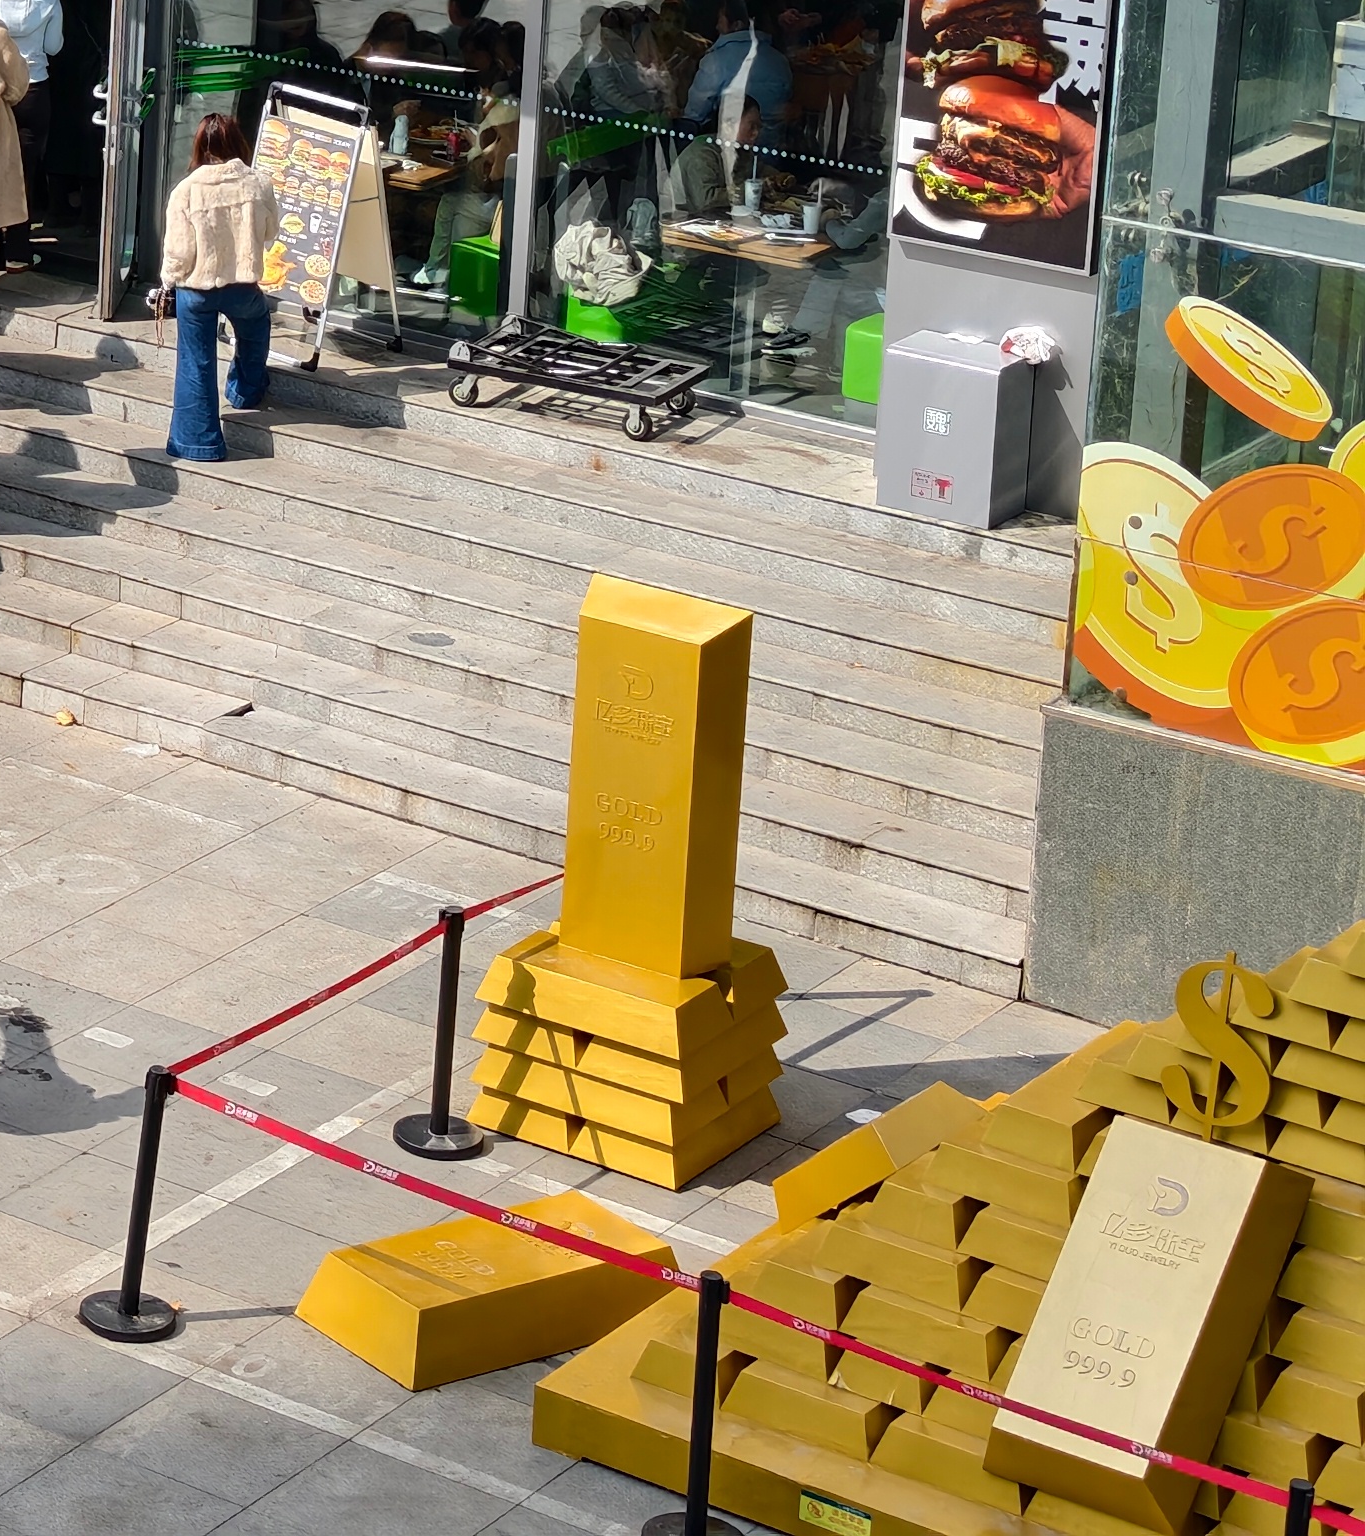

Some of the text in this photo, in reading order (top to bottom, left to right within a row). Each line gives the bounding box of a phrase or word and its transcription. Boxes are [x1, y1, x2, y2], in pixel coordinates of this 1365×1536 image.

[596, 791, 663, 826] GOLD
[599, 821, 655, 852] 999.9
[1118, 1243, 1139, 1258] DUO
[1139, 1251, 1181, 1270] JEWELRY
[1070, 1317, 1157, 1360] GOLD
[1062, 1349, 1137, 1389] 999.9
